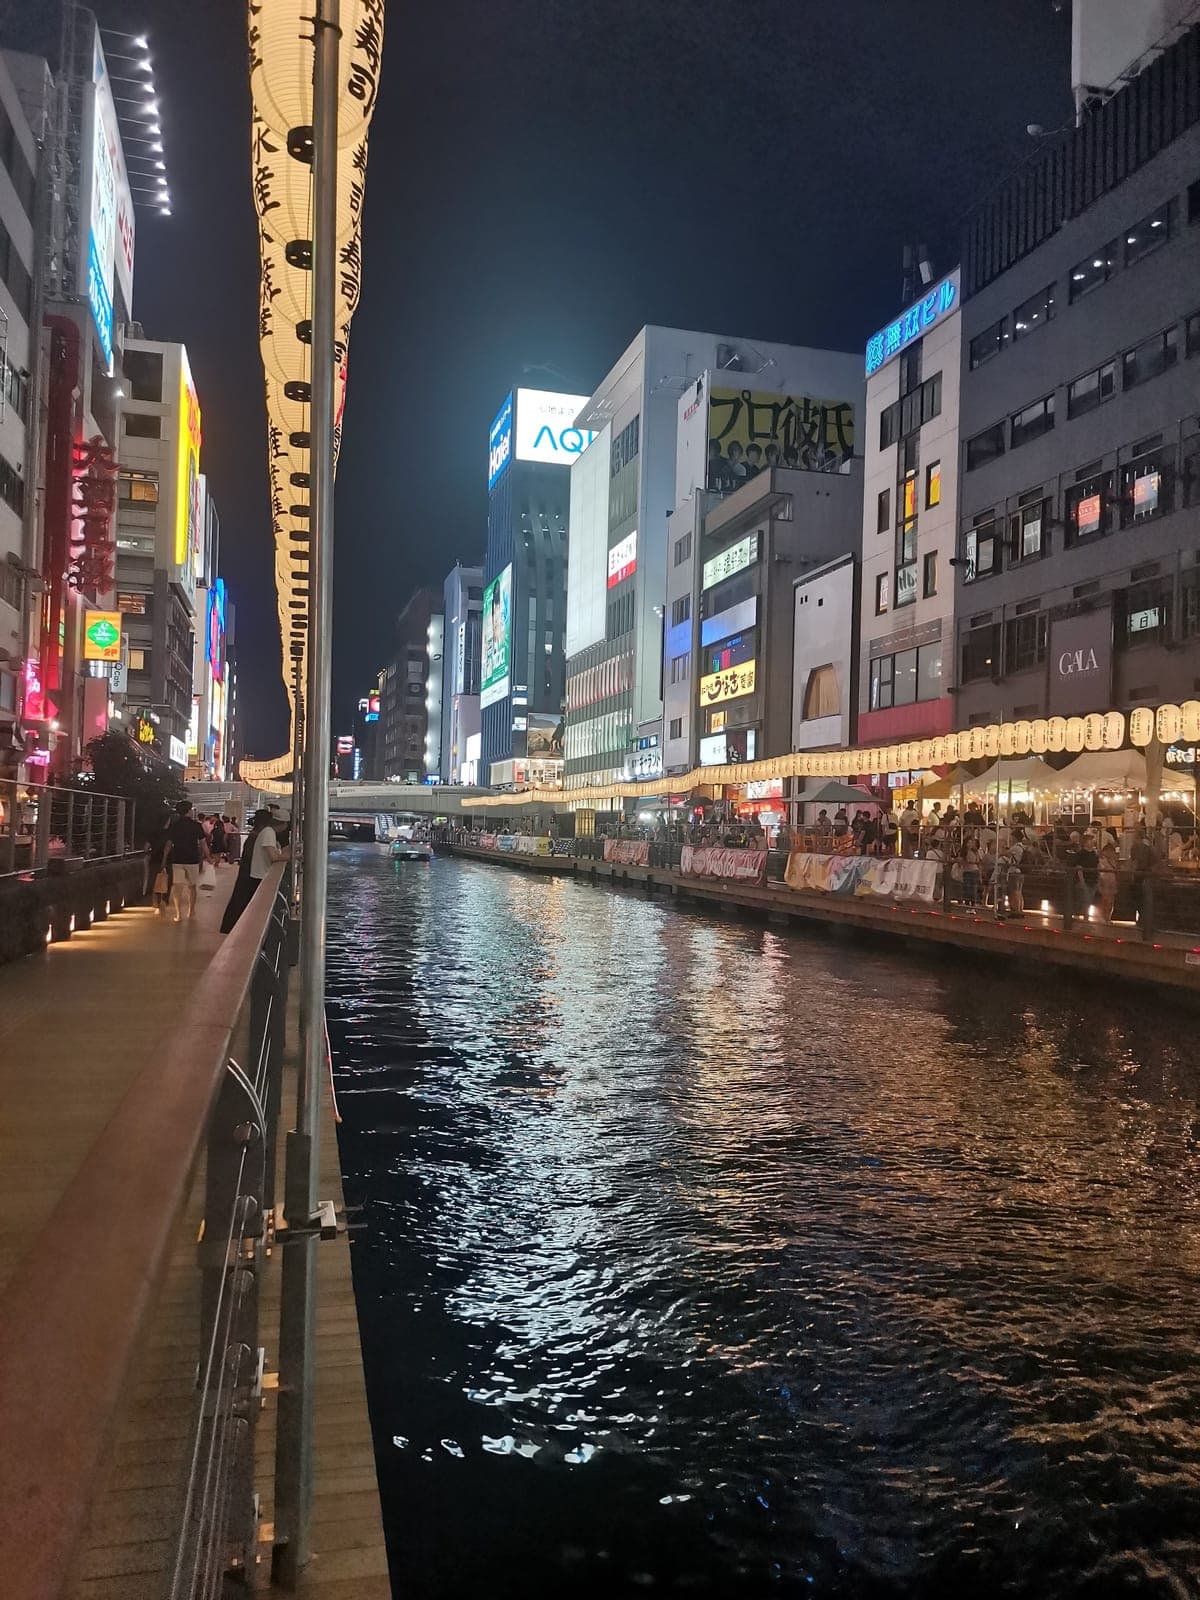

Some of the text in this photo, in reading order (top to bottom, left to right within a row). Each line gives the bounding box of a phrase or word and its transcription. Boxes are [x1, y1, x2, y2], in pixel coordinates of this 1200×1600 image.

[489, 428, 511, 480] Haier
[709, 388, 856, 470] プロ彼氏
[1058, 647, 1098, 675] GALA
